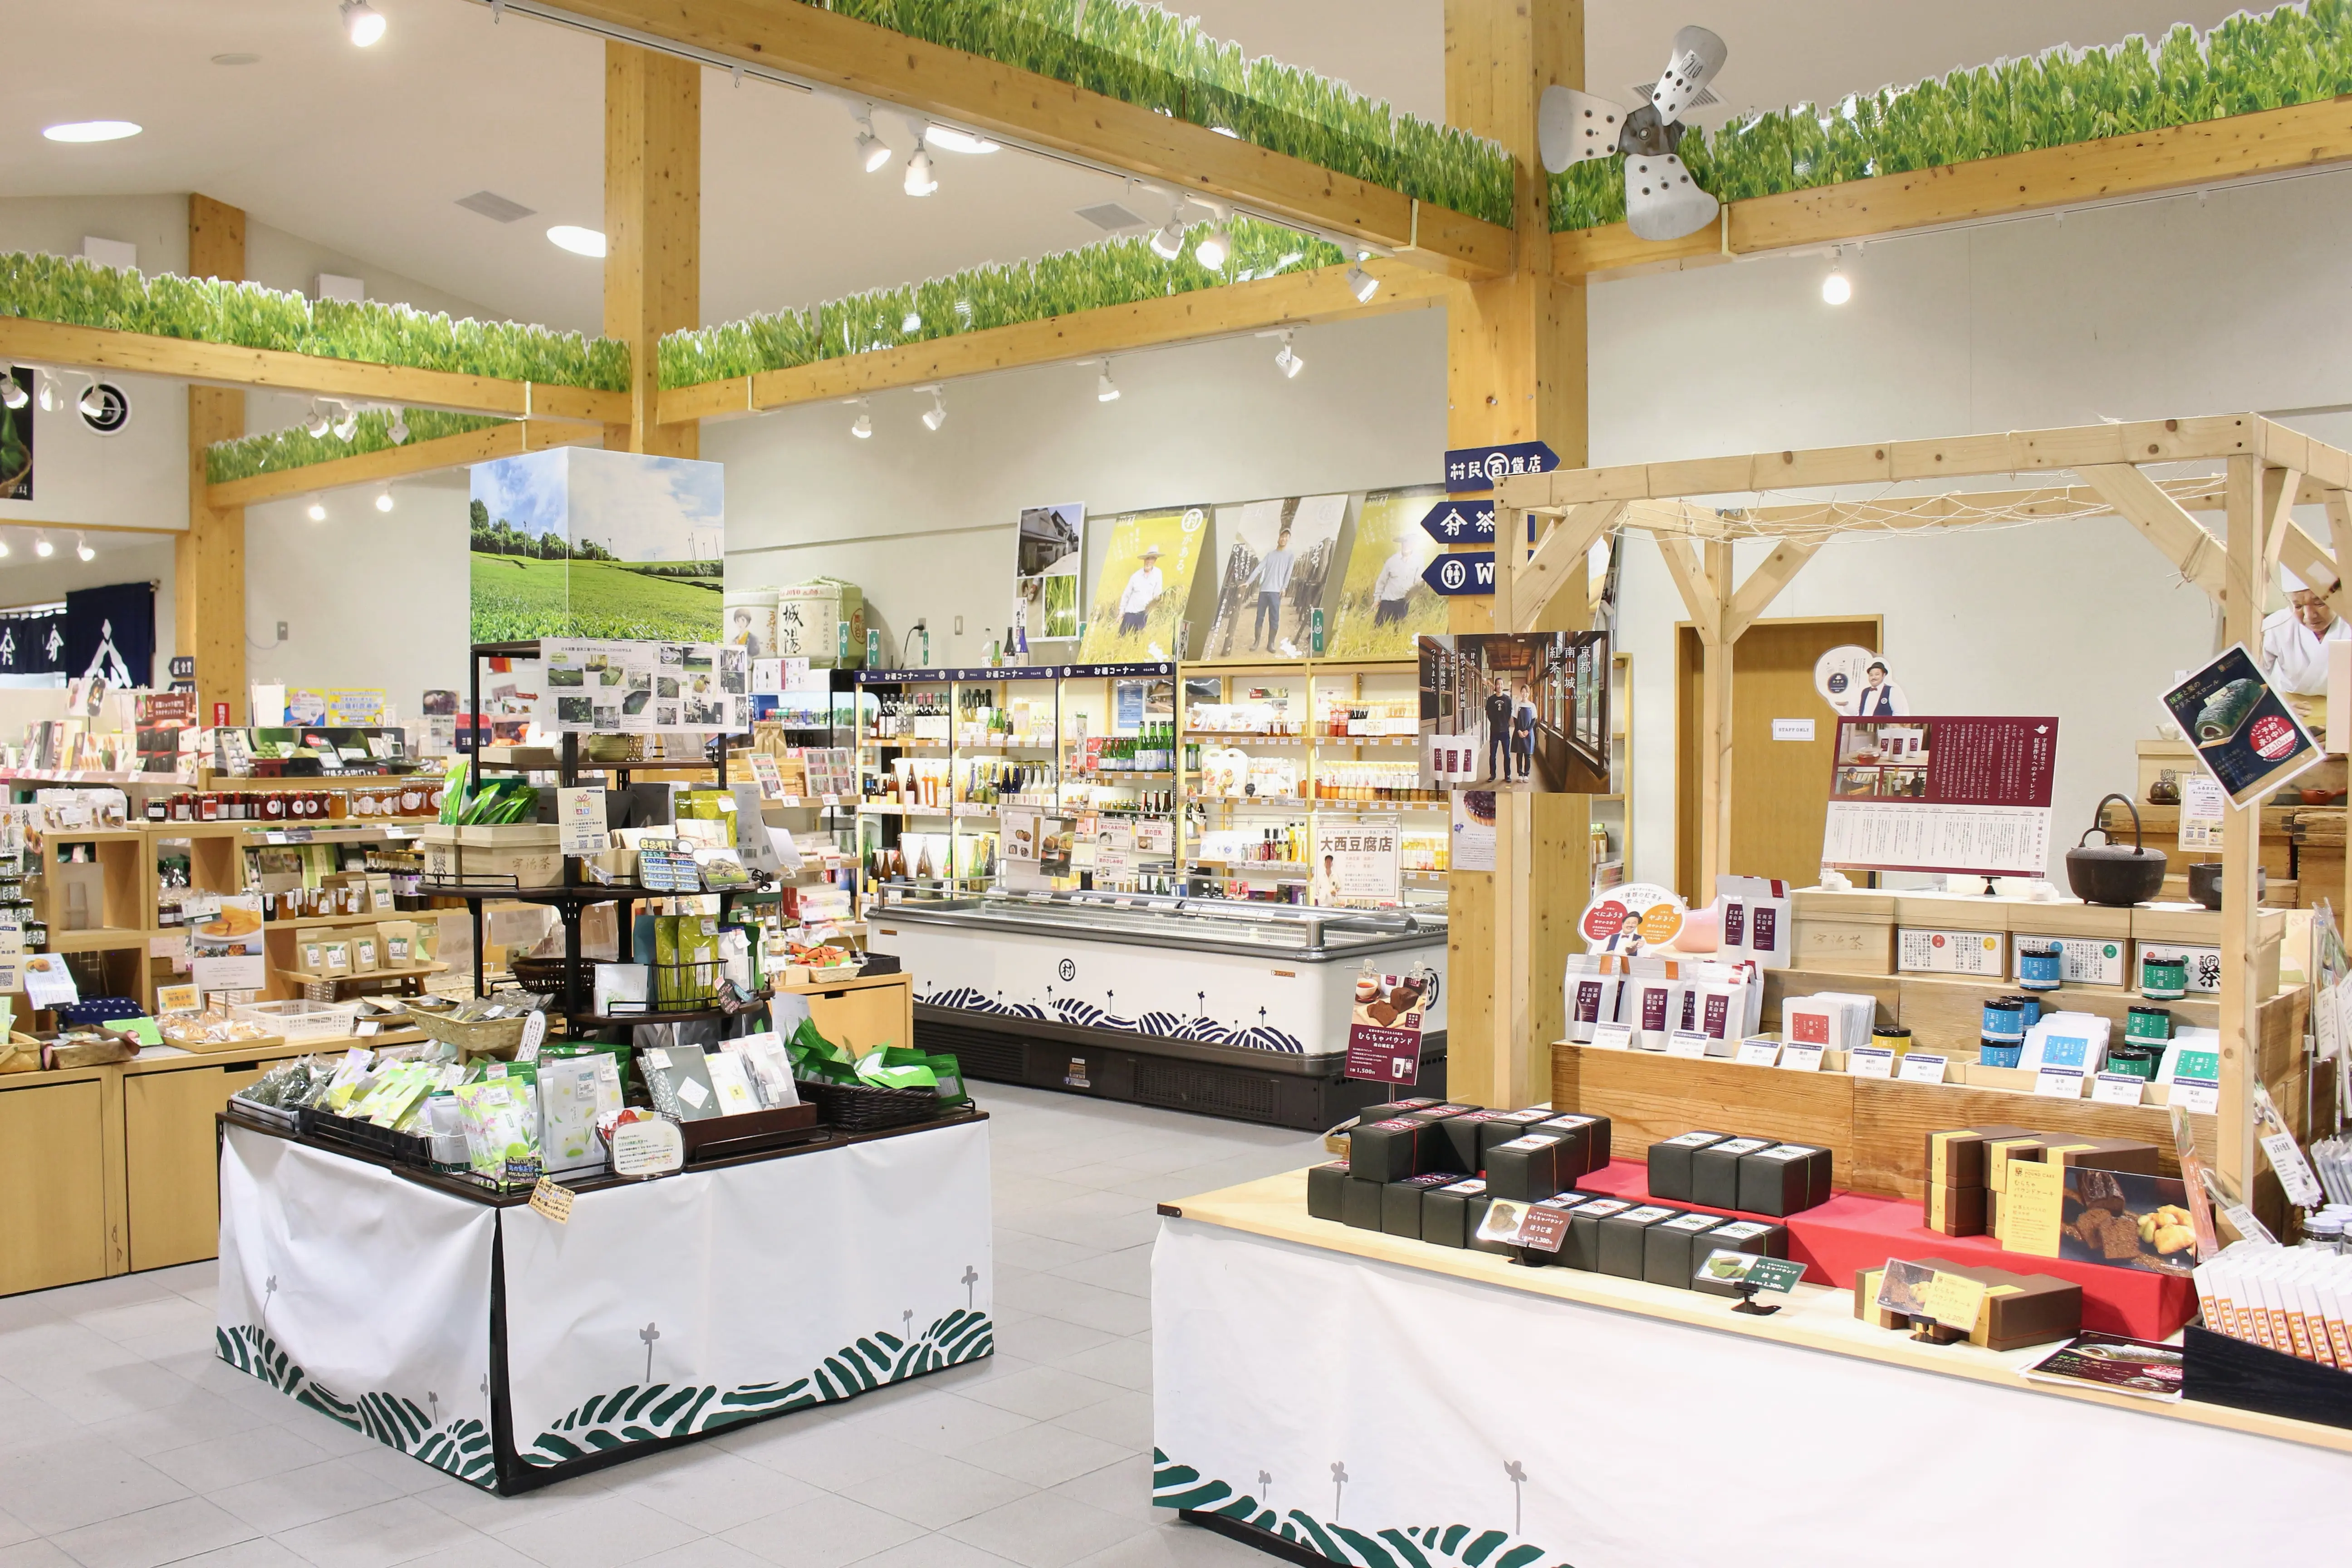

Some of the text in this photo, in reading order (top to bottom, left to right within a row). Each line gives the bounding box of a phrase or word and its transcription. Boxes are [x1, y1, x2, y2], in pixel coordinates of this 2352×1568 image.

[1450, 452, 1541, 481] 村民百貨店
[985, 670, 1024, 678] お酒コーナー
[1094, 666, 1135, 675] お酒コーナー
[1549, 646, 1560, 674] 紅茶
[1564, 646, 1576, 690] 南山城
[1579, 646, 1592, 674] 京都
[885, 671, 919, 681] お酒コーナー
[2175, 679, 2219, 711] クリスマスロール
[2029, 737, 2040, 800] 紅茶作りへのチャレンジ
[1321, 836, 1393, 852] 大西豆腐店
[513, 856, 551, 871] 宇治茶
[1813, 934, 1863, 951] 宇治茶
[1358, 1032, 1412, 1045] むらちゃパウンド
[2014, 1187, 2054, 1196] パウンドケーキ
[1528, 1214, 1564, 1225] むらちゃパウンド
[1529, 1225, 1553, 1234] ほうじ茶
[1756, 1264, 1797, 1274] むらちゃパウンド
[2204, 1299, 2217, 1330] CURR
[2239, 1312, 2253, 1342] CURR
[2273, 1313, 2289, 1352] CURRY
[2291, 1316, 2309, 1355] CURRY
[2311, 1319, 2330, 1358] CURRY
[2332, 1324, 2351, 1363] CURRY
